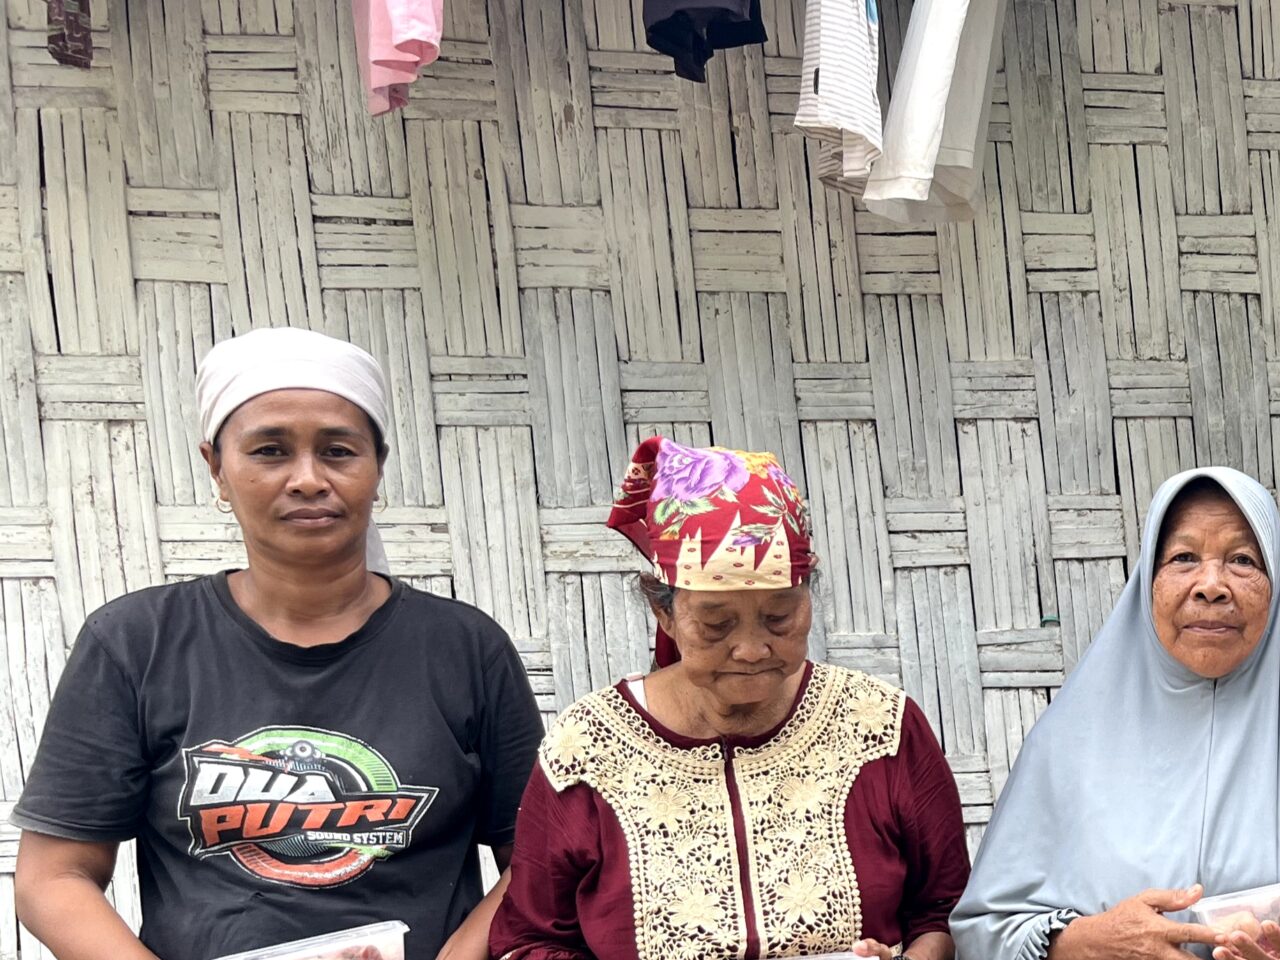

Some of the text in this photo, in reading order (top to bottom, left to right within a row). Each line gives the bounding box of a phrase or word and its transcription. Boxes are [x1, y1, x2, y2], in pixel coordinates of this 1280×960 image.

[190, 762, 336, 807] DUA
[200, 798, 416, 847] PUTRI
[306, 831, 403, 844] SOUND SYSTEM
